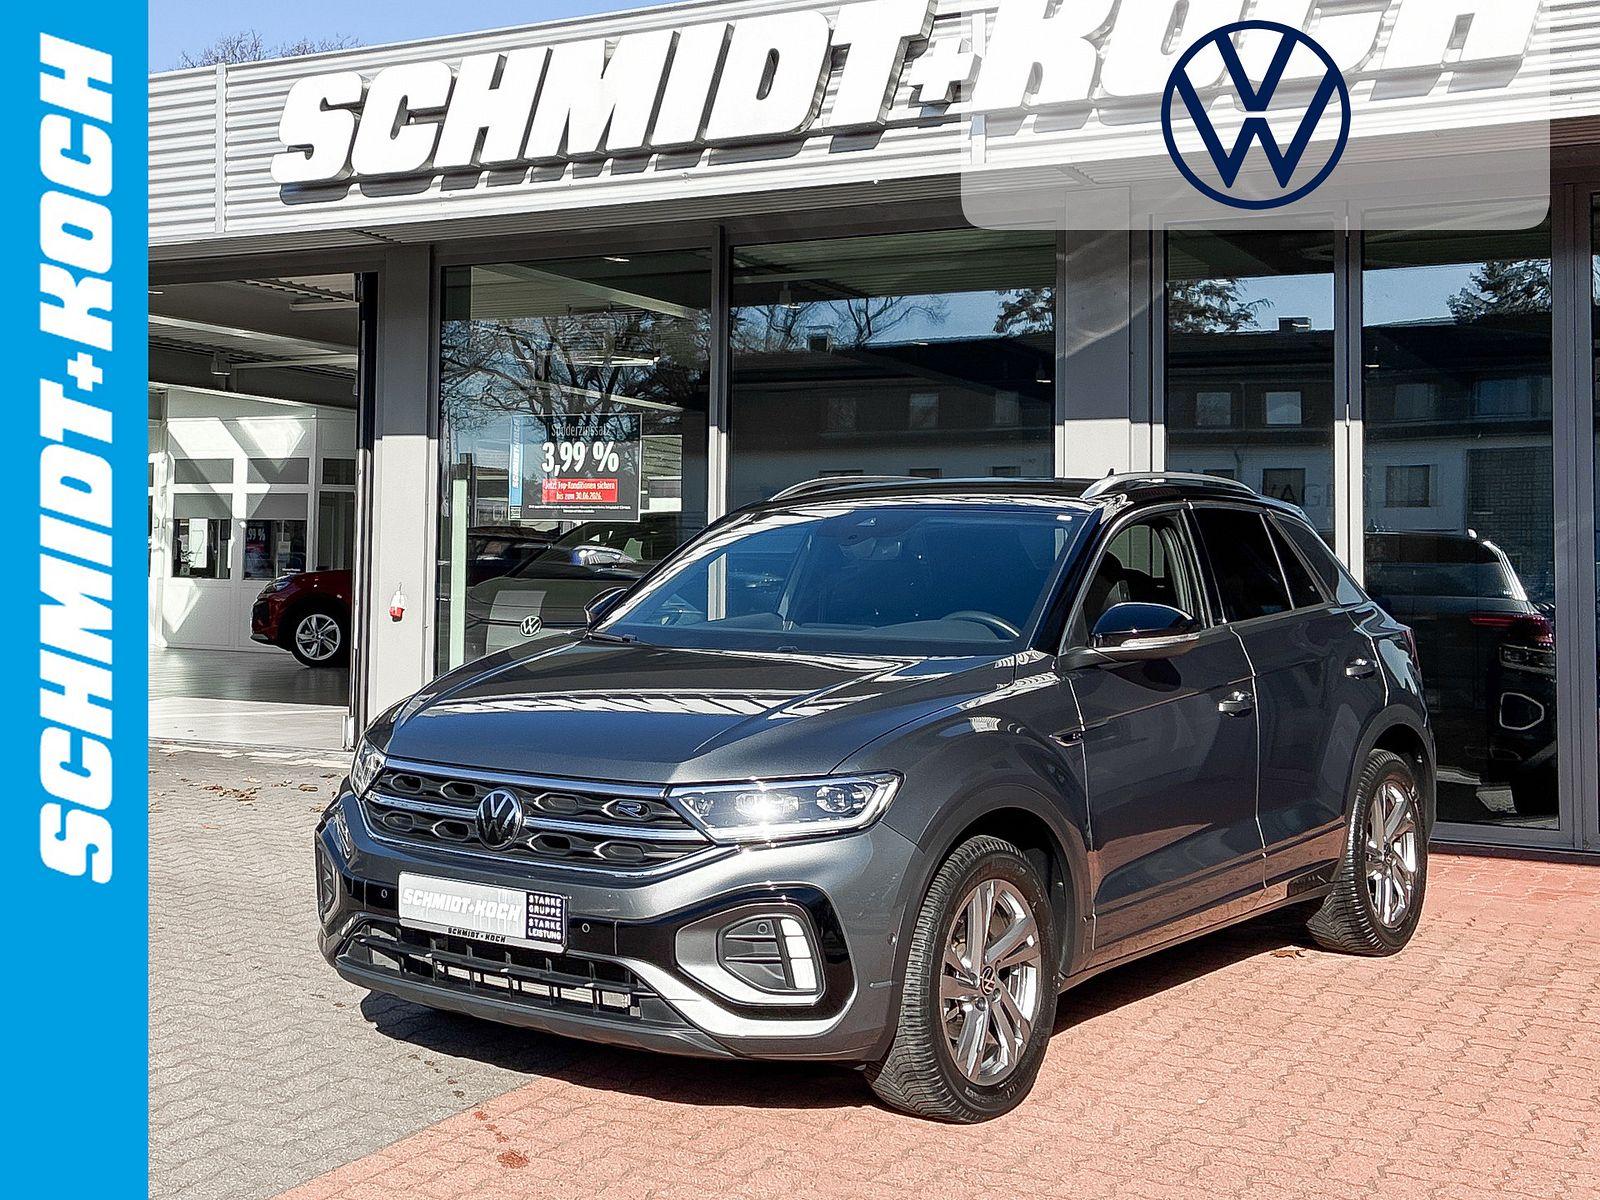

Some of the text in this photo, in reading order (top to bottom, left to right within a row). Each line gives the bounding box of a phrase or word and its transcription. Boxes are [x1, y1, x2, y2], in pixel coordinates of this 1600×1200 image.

[541, 441, 620, 477] 3,99 %
[528, 894, 562, 908] STARKE
[528, 904, 562, 917] GRUPPE
[528, 918, 562, 931] STARKE
[528, 927, 562, 941] LEISTUNG
